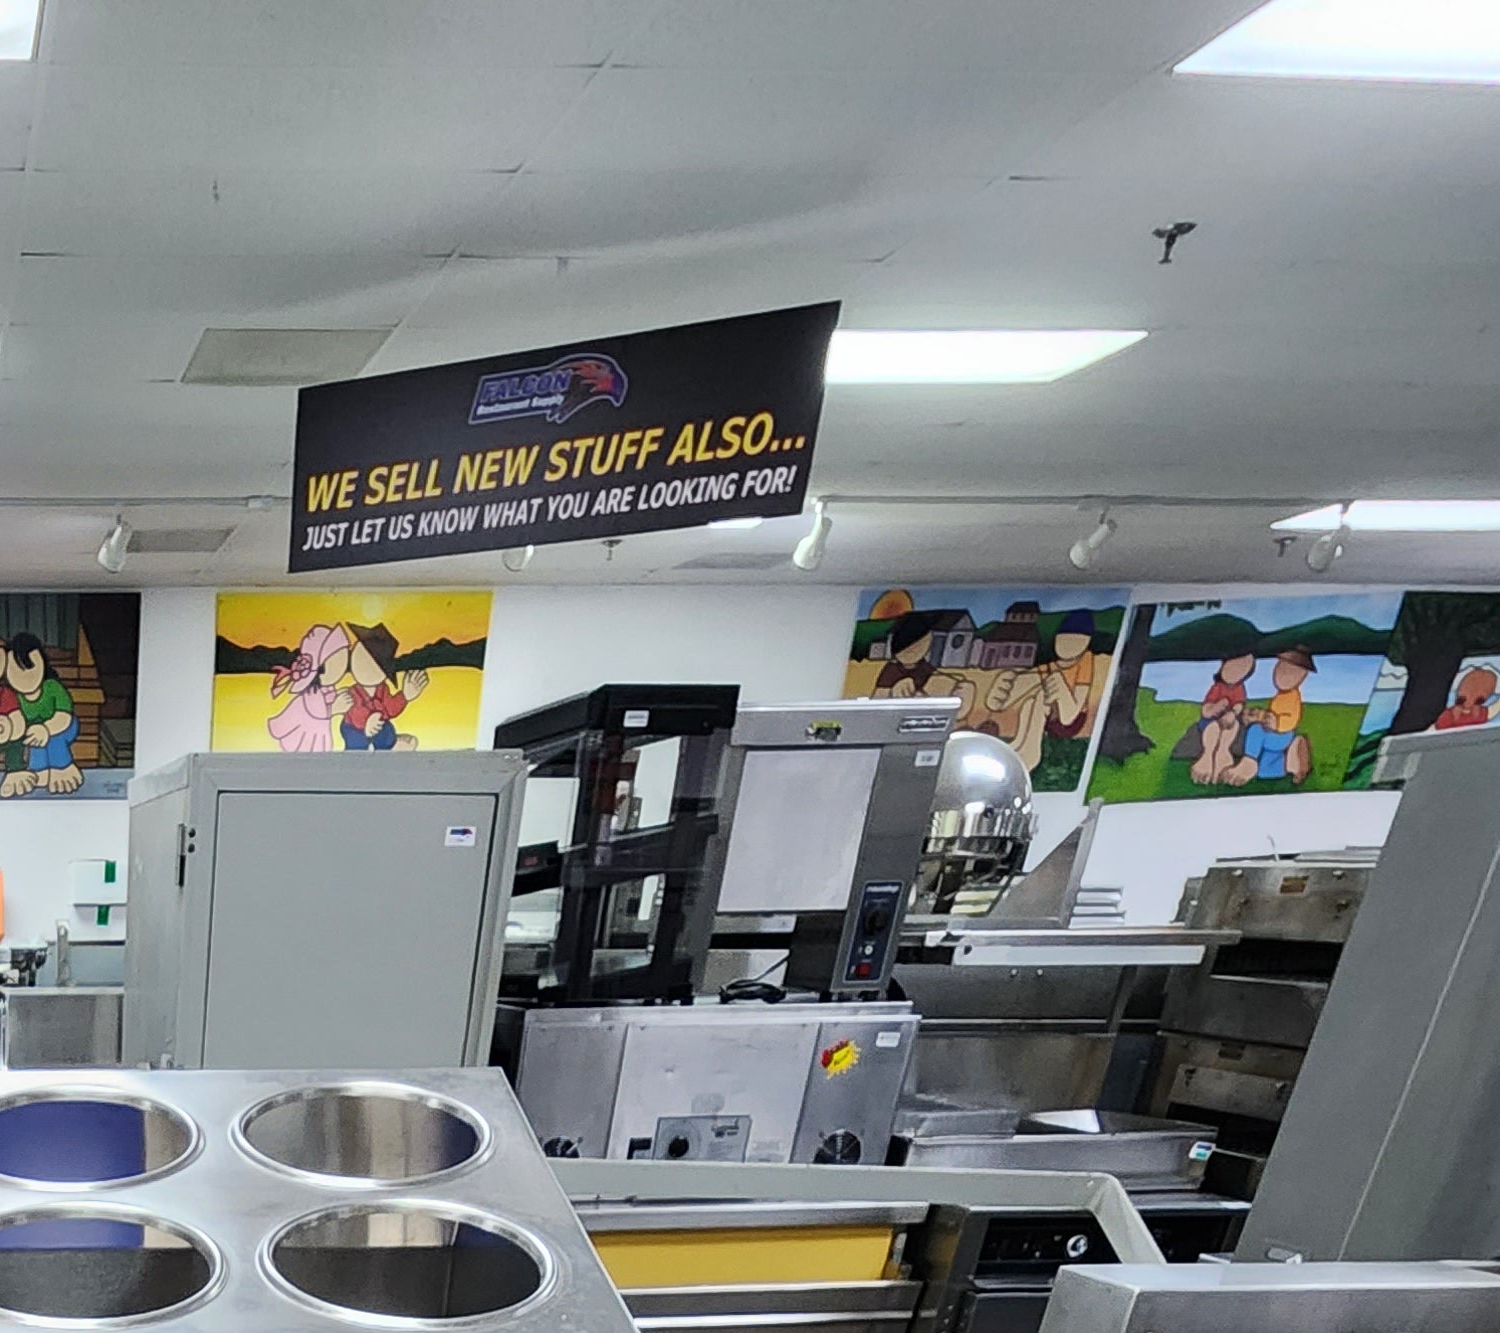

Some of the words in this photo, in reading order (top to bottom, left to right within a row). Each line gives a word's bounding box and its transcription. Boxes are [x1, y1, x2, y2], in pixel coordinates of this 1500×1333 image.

[480, 369, 573, 403] FALCON
[307, 471, 359, 513] WE
[364, 459, 443, 506] SELL
[453, 444, 541, 494] NEW
[543, 427, 665, 482] STUFF
[665, 411, 806, 467] ALSO...
[302, 522, 350, 551] JUST
[351, 517, 386, 545] LET
[388, 514, 416, 540] US
[417, 505, 480, 537] KNOW
[482, 498, 544, 529] WHAT
[546, 491, 591, 521] YOU
[591, 485, 637, 516] ARE
[637, 472, 740, 511] LOOKING
[741, 465, 798, 498] FOR!
